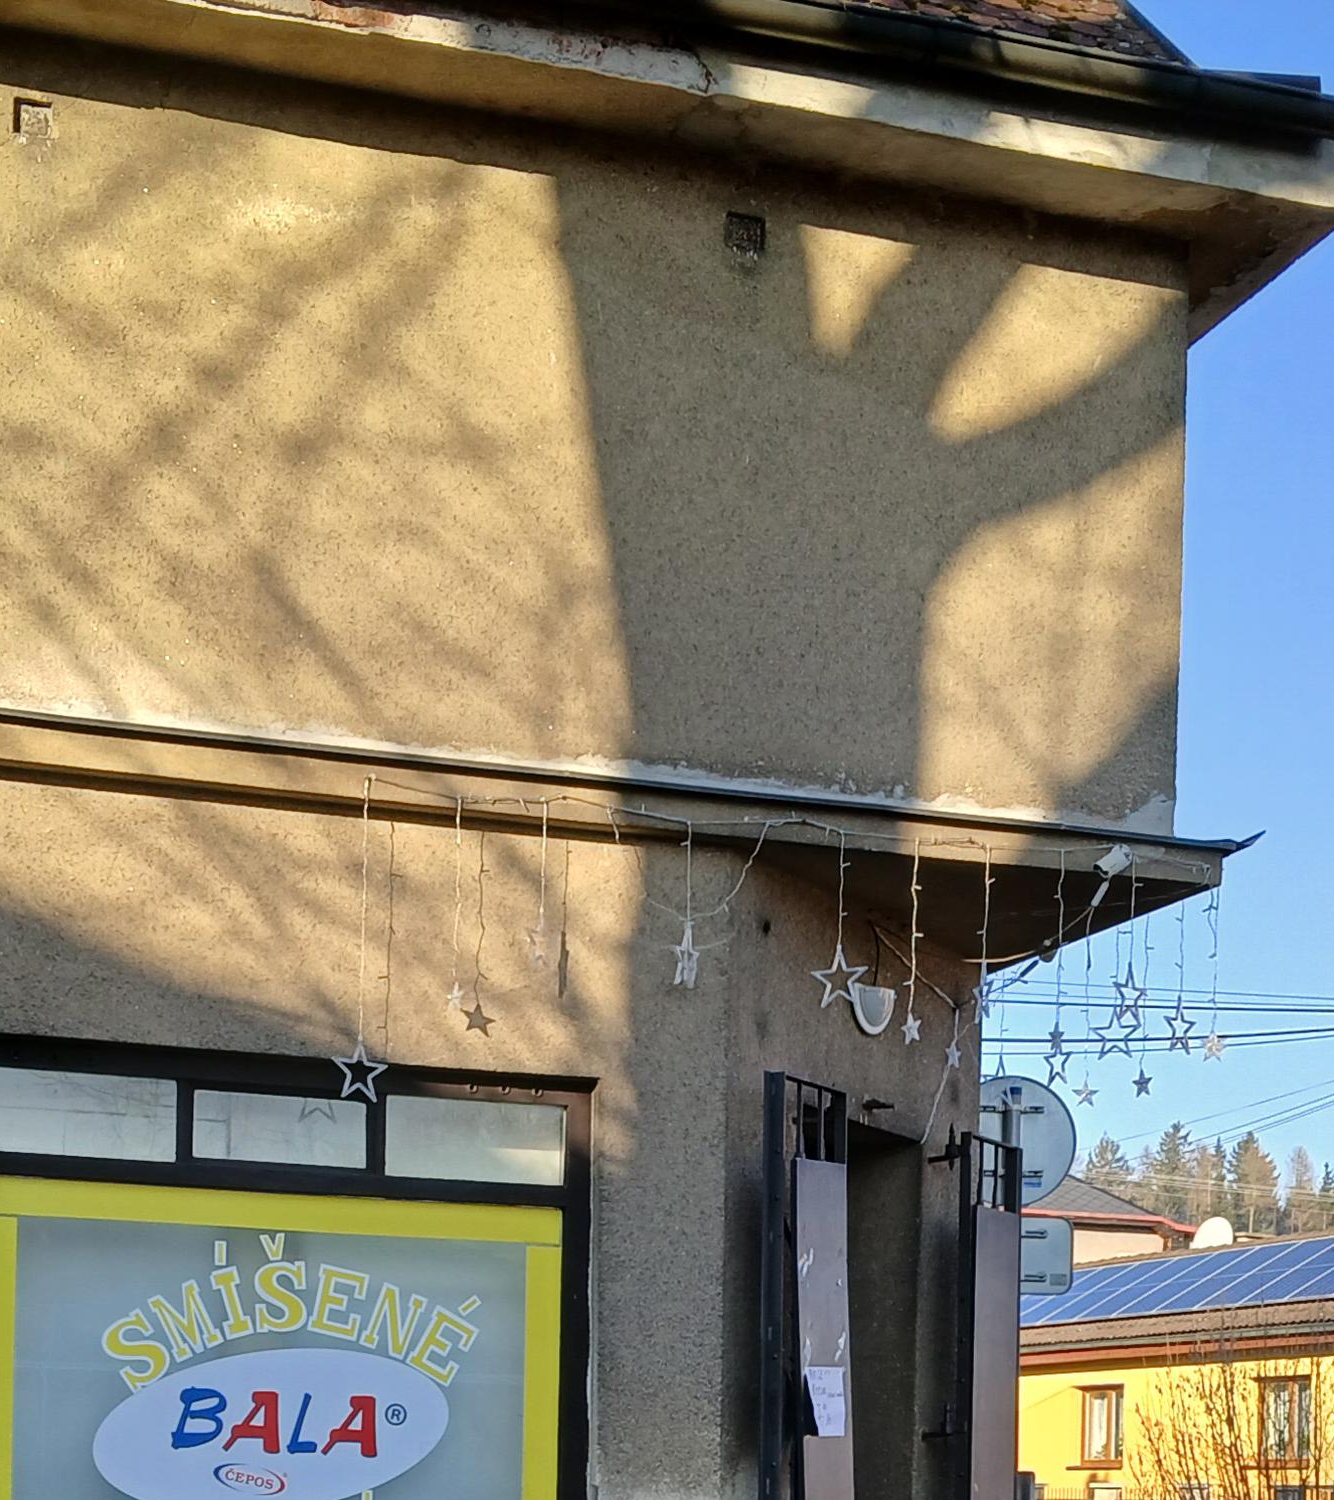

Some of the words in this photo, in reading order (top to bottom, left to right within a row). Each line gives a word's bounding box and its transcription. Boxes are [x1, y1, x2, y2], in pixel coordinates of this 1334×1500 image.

[101, 1232, 481, 1392] SMÍŠENÉ
[170, 1386, 378, 1458] BALA
[225, 1468, 274, 1489] ČEPOS
